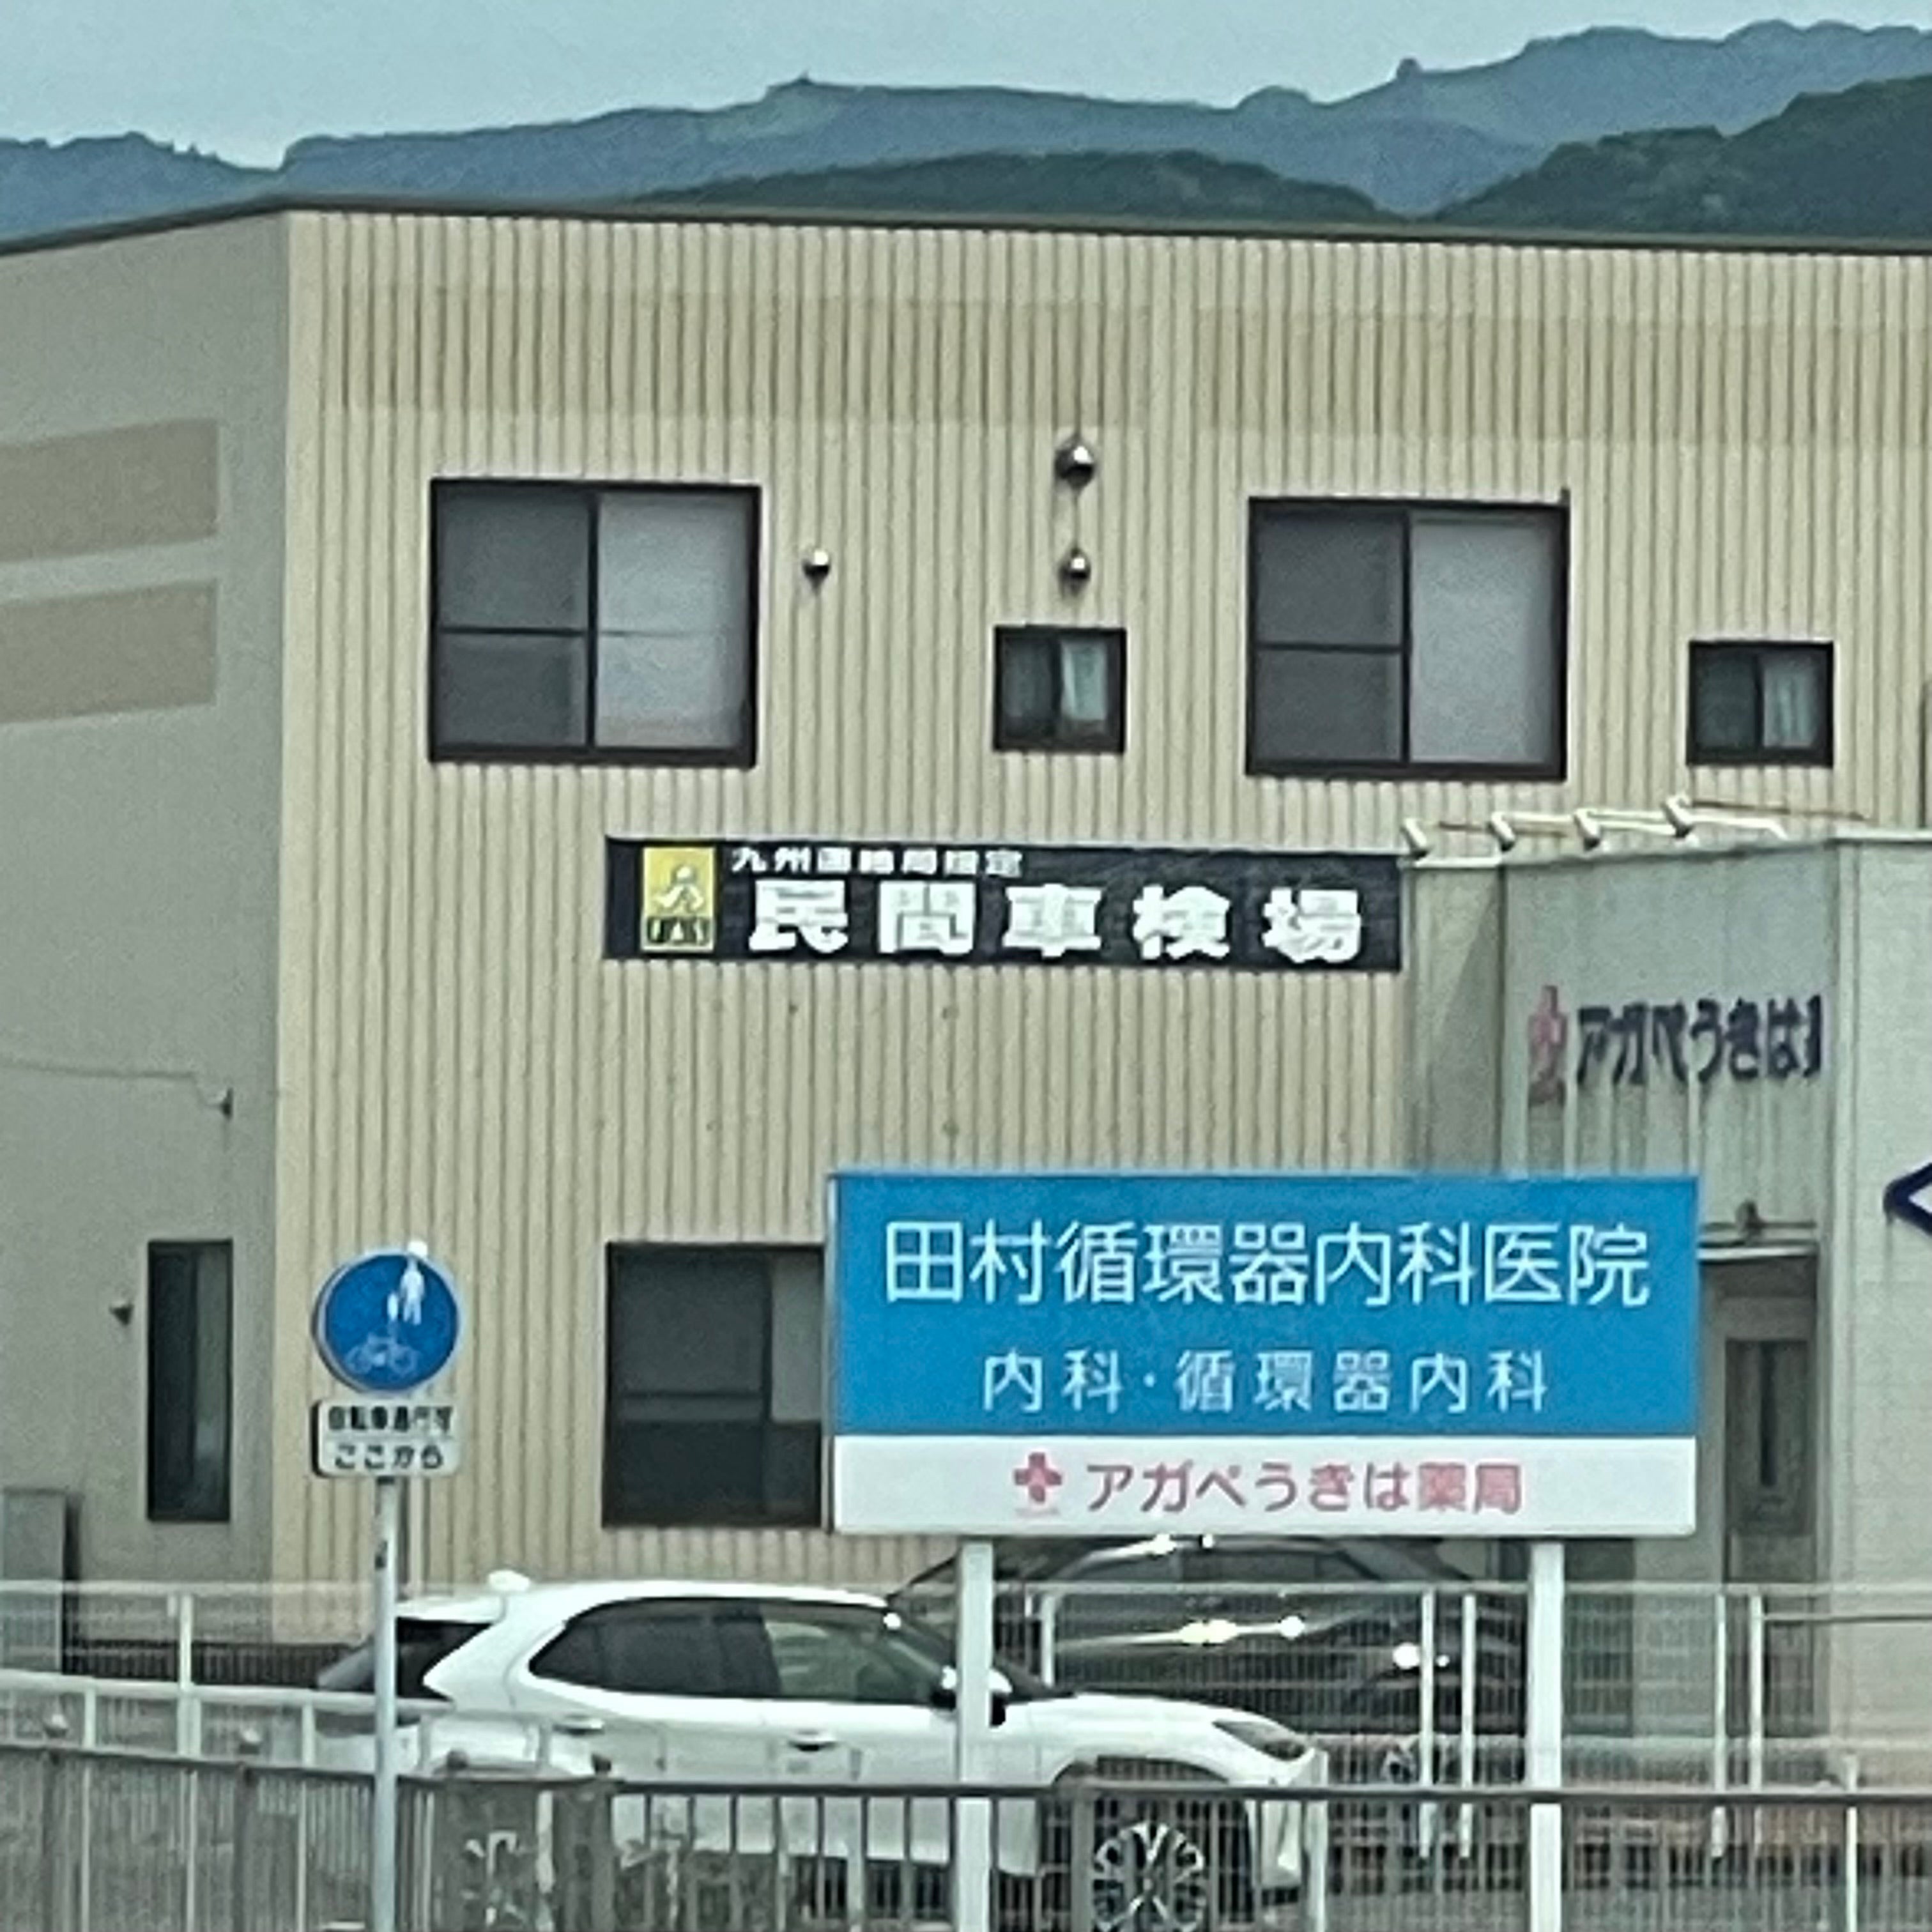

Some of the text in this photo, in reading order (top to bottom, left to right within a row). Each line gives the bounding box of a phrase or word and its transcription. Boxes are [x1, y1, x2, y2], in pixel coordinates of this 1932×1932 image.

[750, 879, 1362, 963] 民間車検場
[1577, 994, 1822, 1084] アガペうきは
[885, 1219, 1650, 1307] 田村循環器内科医院
[983, 1349, 1547, 1413] 内科・循環器内科
[334, 1445, 443, 1469] ここから
[1086, 1459, 1522, 1514] アガペうきは薬局
